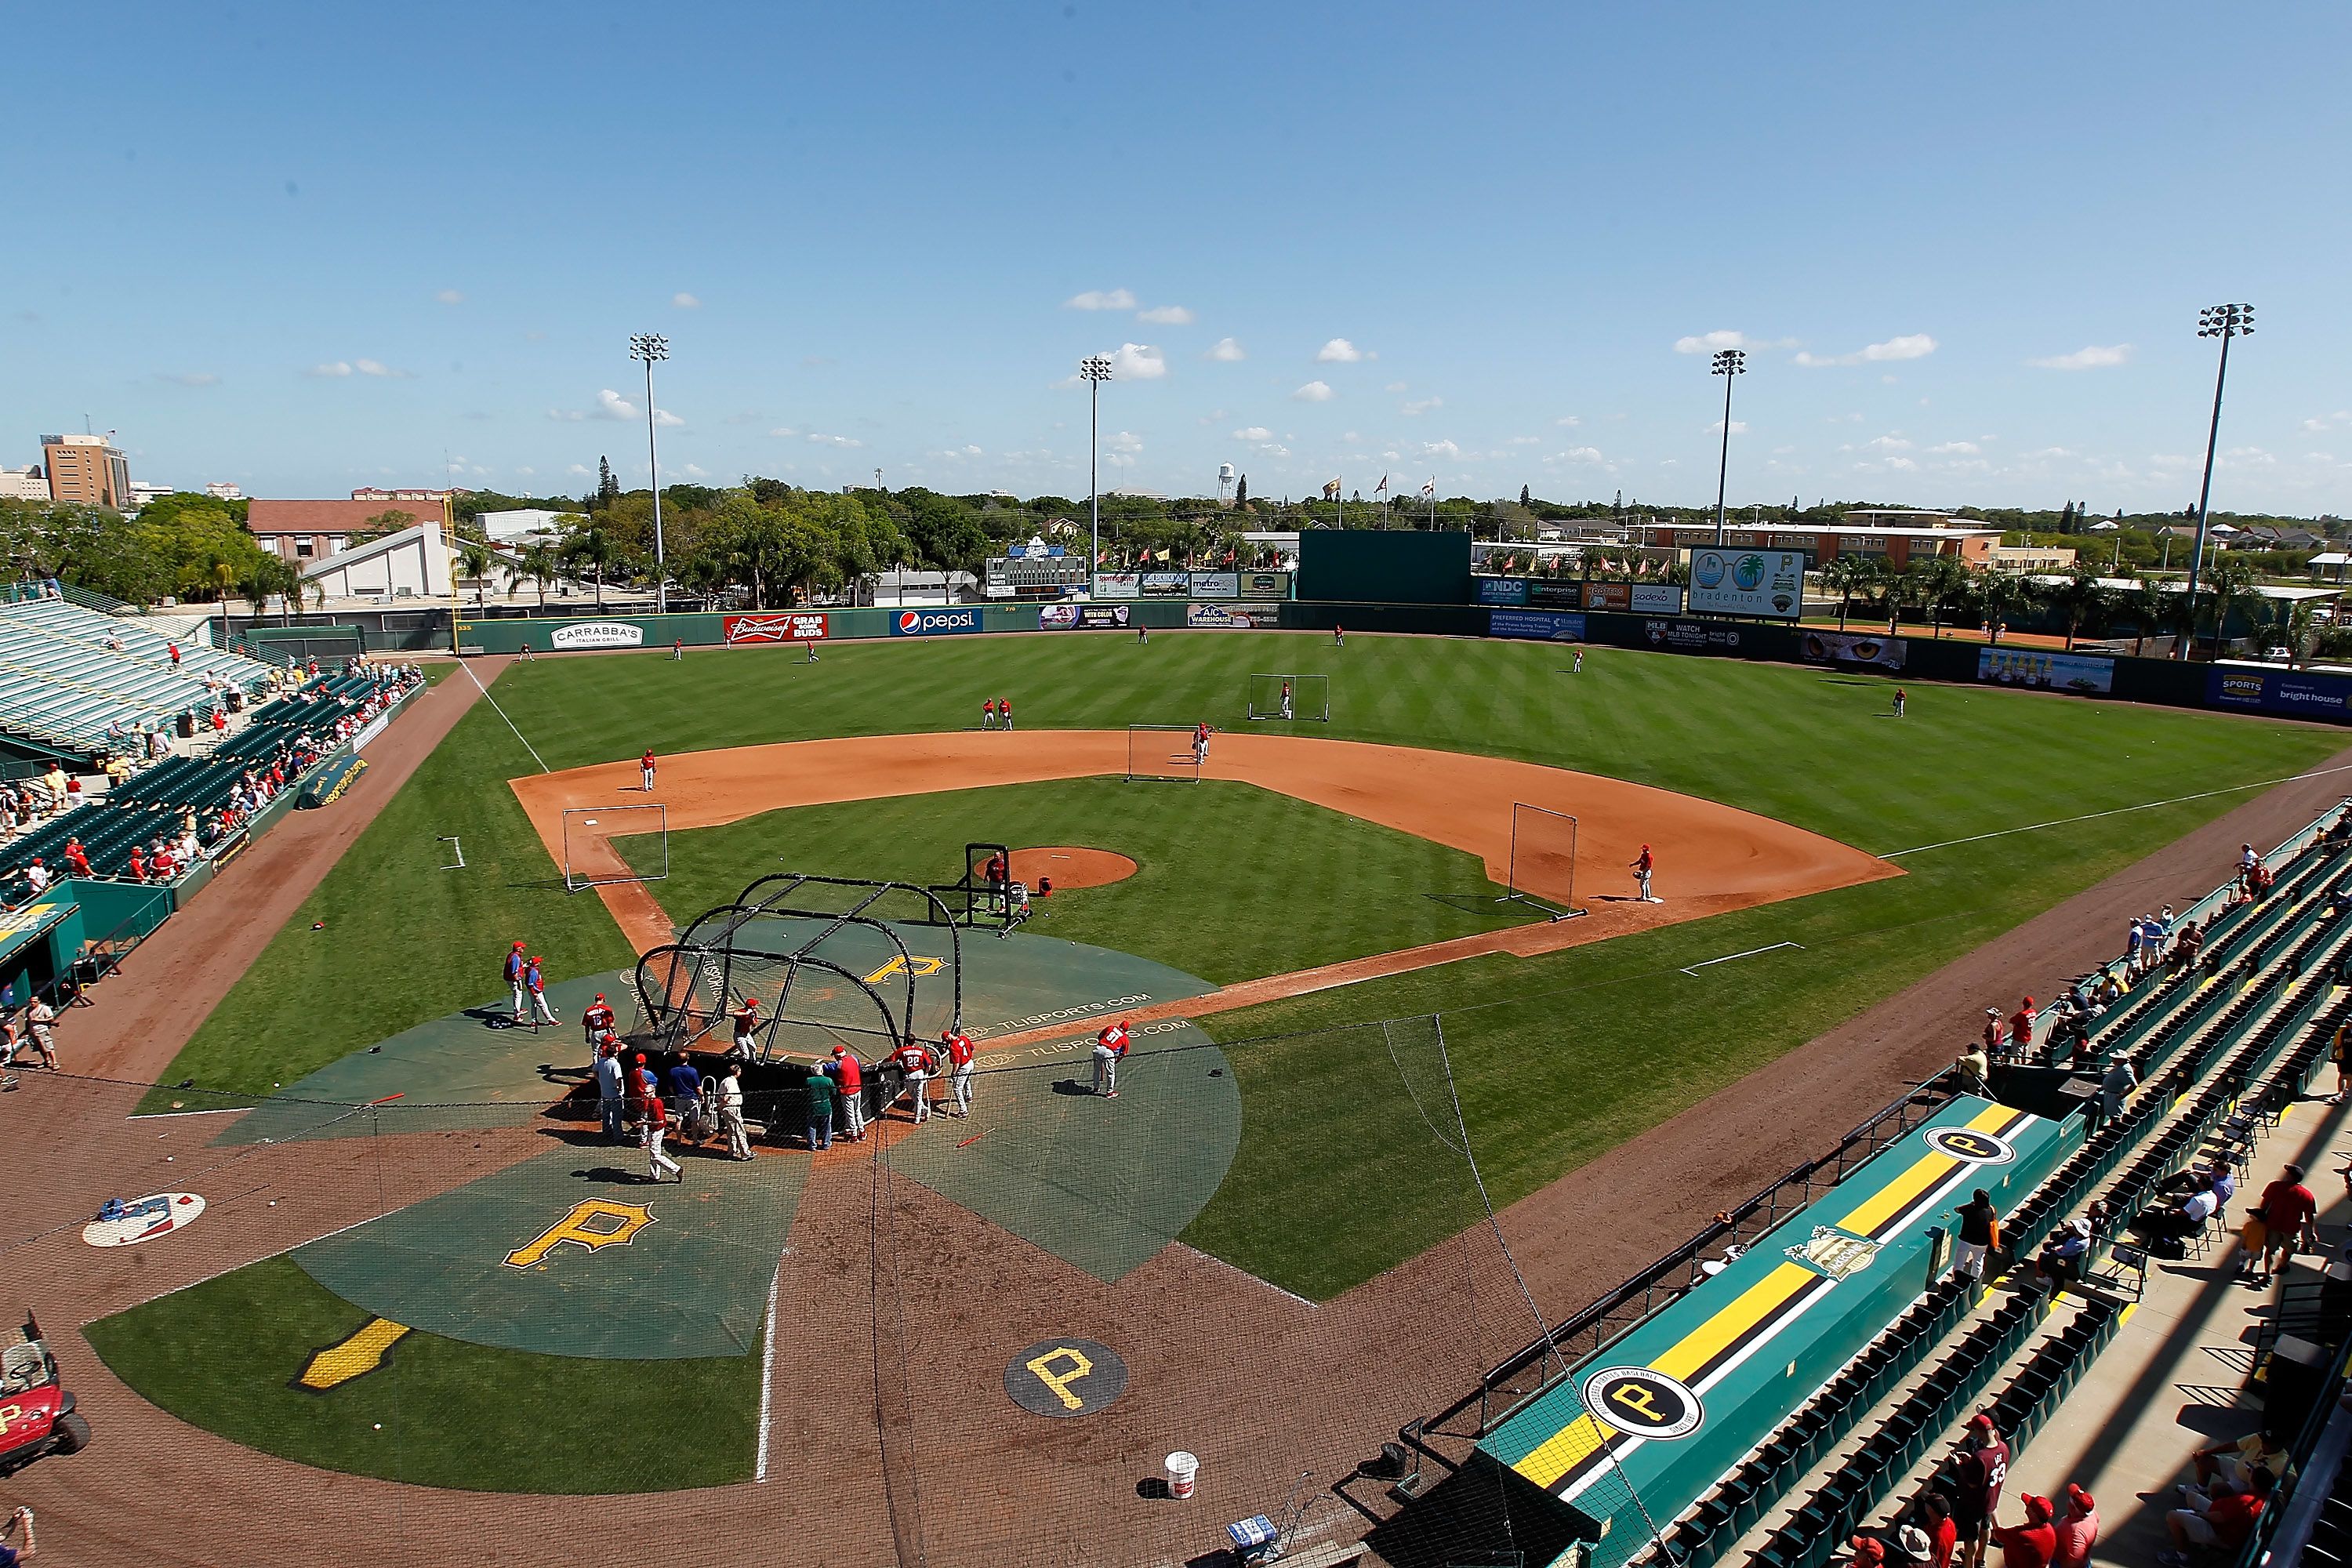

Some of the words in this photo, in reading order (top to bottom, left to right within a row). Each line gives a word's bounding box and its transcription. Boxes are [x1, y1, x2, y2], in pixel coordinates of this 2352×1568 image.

[1494, 581, 1522, 592] NDC
[1587, 587, 1624, 596] HOOTERS
[1633, 589, 1668, 601] sodexo
[1693, 590, 1762, 603] bradenton
[557, 627, 638, 641] CARRABBA'S
[731, 623, 789, 633] Budweiser
[2223, 681, 2262, 691] SPORTS
[2280, 691, 2310, 701] bright
[2311, 693, 2343, 704] house
[996, 993, 1152, 1030] TLISPORTS.COM
[1025, 1018, 1192, 1057] TLISPOS.COM
[501, 1197, 660, 1269] P
[1025, 1347, 1094, 1410] P
[1595, 1371, 1620, 1385] PIRATES
[1621, 1370, 1657, 1380] BASEBALL
[1989, 1462, 2006, 1487] 33
